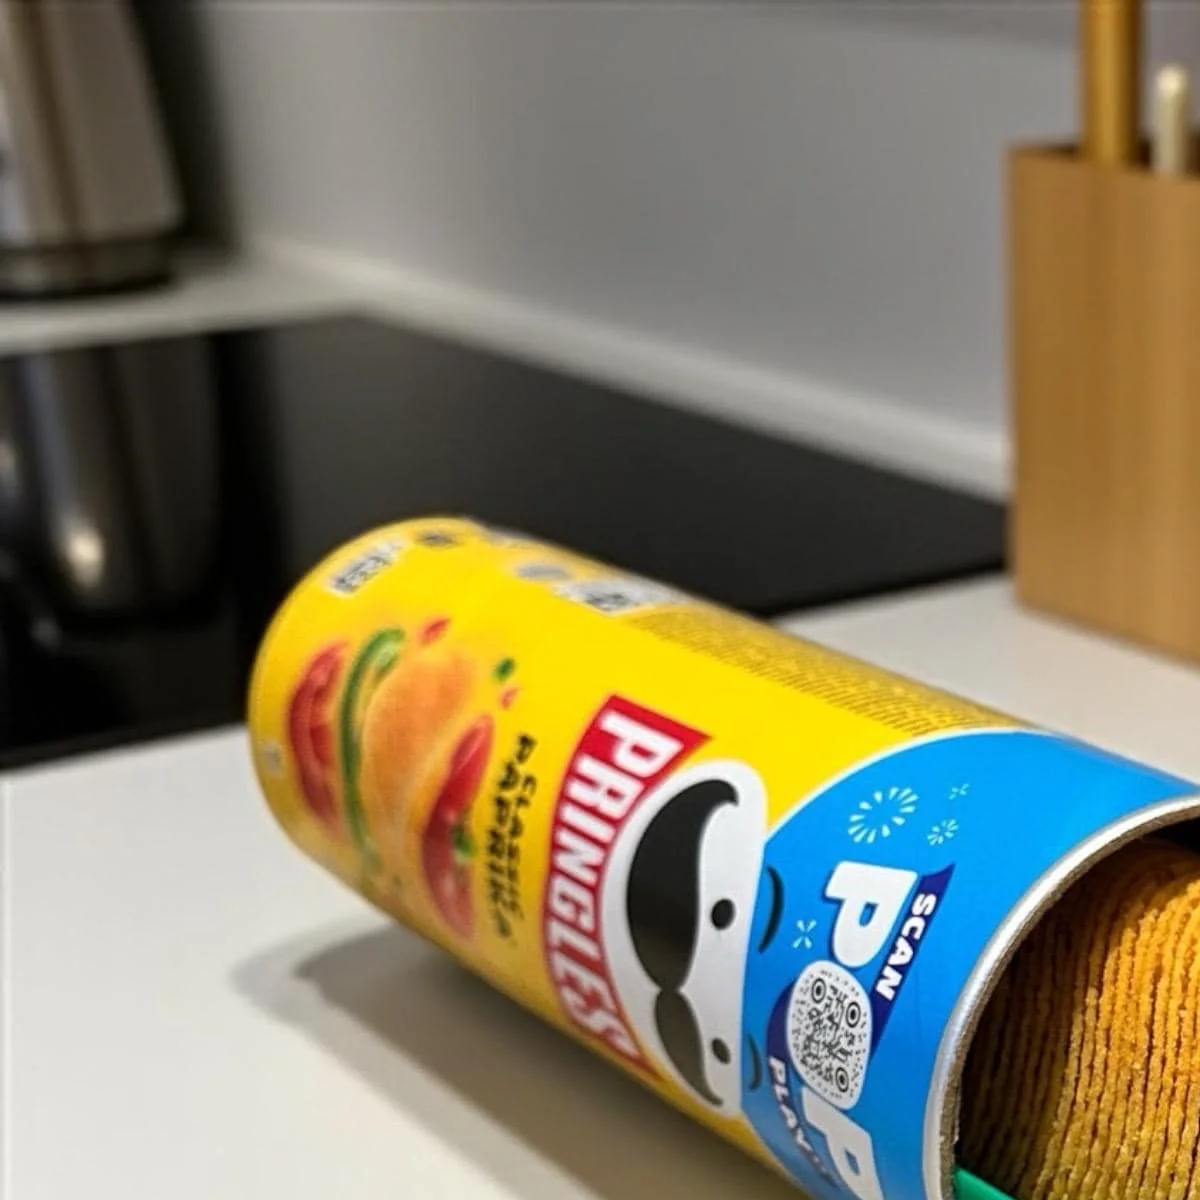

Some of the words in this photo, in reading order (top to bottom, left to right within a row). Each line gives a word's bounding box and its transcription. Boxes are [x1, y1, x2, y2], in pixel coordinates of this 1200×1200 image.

[486, 733, 537, 946] PAPRIKA
[546, 709, 685, 1060] PRINGLES
[875, 893, 938, 1001] SCAN
